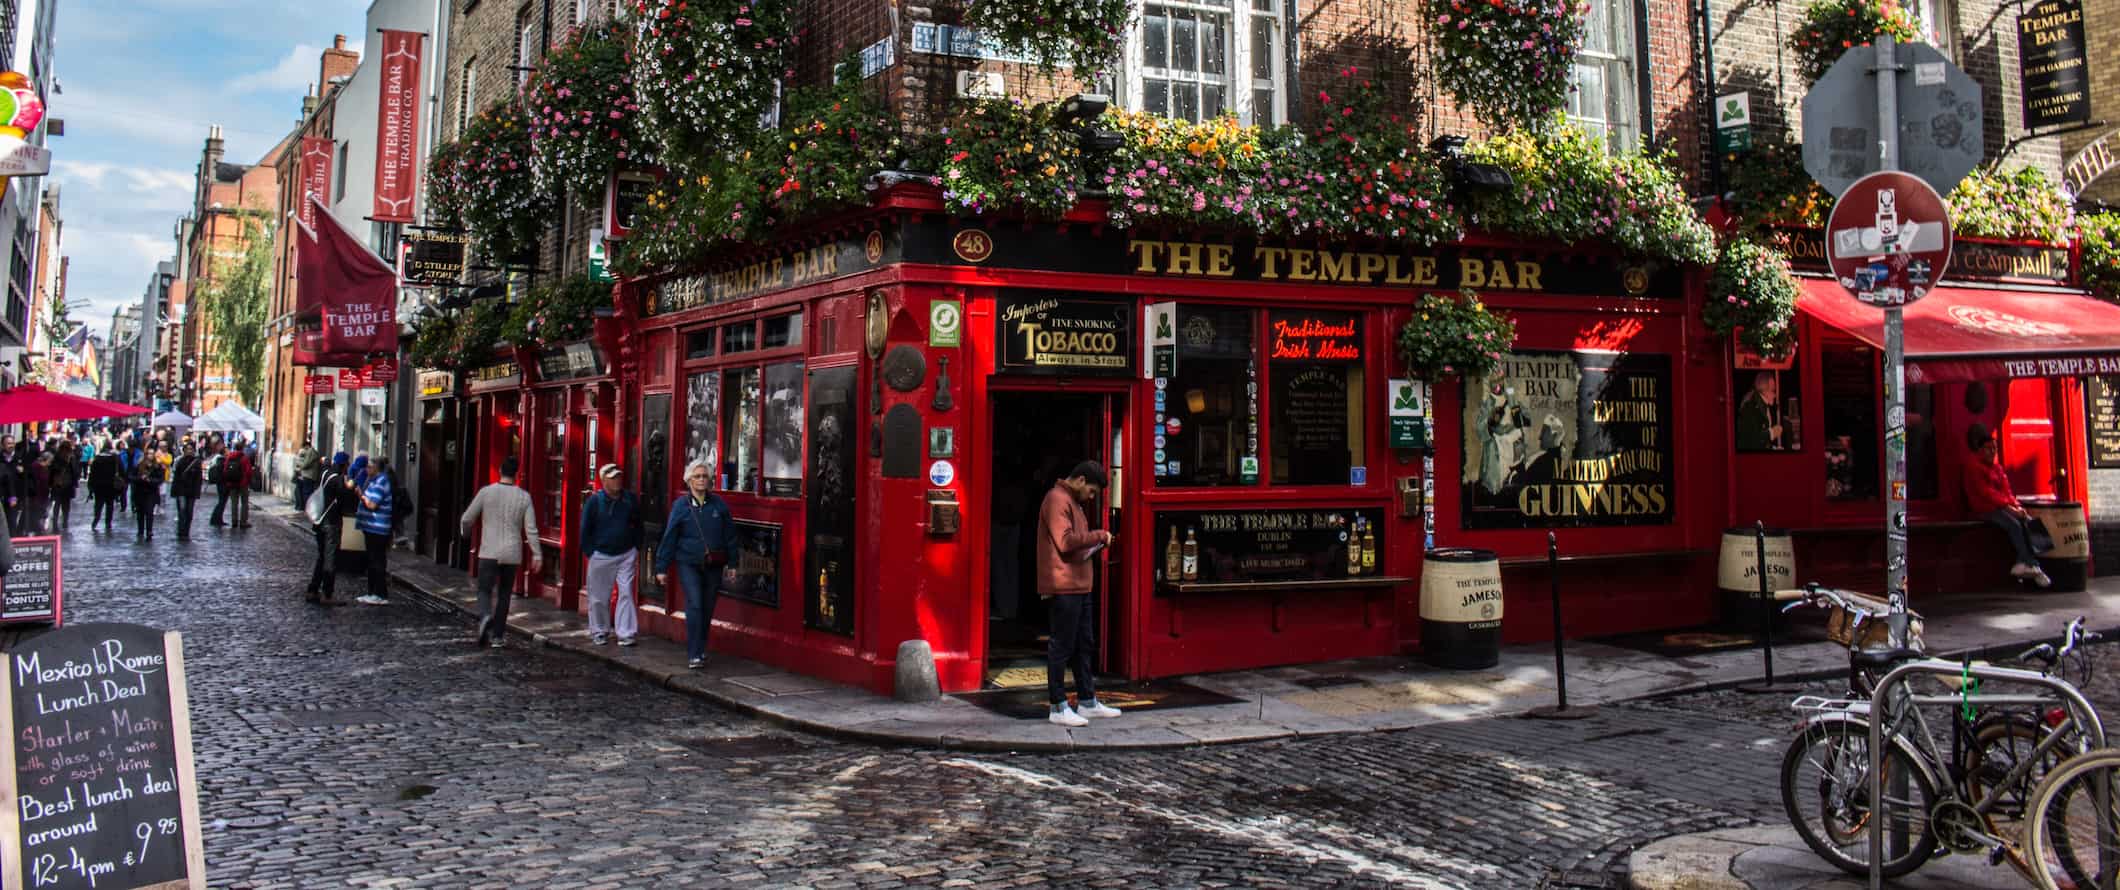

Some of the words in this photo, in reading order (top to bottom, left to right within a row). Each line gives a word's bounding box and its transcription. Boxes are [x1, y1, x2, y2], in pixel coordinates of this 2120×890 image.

[2039, 3, 2059, 15] THE
[2020, 10, 2080, 32] TEMPLE
[2035, 29, 2069, 46] BAR
[2047, 58, 2082, 72] GARDEN
[389, 65, 402, 95] BAR
[2029, 97, 2050, 109] LIVE
[2052, 92, 2082, 104] MUSIC
[2042, 104, 2070, 117] DAILY
[385, 98, 400, 157] TEMPLE
[400, 110, 412, 168] TRADING
[384, 160, 397, 190] THE
[2068, 143, 2115, 192] THE
[961, 234, 985, 254] 48
[711, 257, 783, 302] TEMPLE
[793, 244, 838, 284] BAR
[1130, 240, 1235, 277] THE
[1256, 247, 1437, 285] TEMPLE
[1459, 258, 1543, 289] BAR
[327, 310, 391, 326] TEMPLE
[345, 303, 372, 313] THE
[1002, 298, 1059, 321] Importers
[1037, 311, 1048, 320] OF
[343, 325, 376, 338] BAR
[1052, 318, 1073, 328] FINE
[1074, 319, 1116, 329] SMOKING
[1275, 319, 1356, 337] Traditional
[1017, 322, 1117, 360] TOBACCO
[1271, 338, 1310, 358] Irish
[1316, 339, 1359, 358] Music
[1037, 355, 1073, 366] Always
[2005, 360, 2037, 377] THE
[2038, 358, 2097, 375] TEMPLE
[1501, 362, 1575, 380] TEMPLE
[1525, 380, 1560, 399] BAR
[1629, 377, 1657, 398] THE
[1592, 400, 1657, 422] EMPEROR
[1641, 426, 1657, 446] OF
[1552, 457, 1608, 481] MALTED
[1518, 483, 1666, 517] GUINNESS
[1200, 514, 1236, 529] THE
[1240, 513, 1307, 529] TEMPLE
[8, 562, 49, 572] OFFEE
[1744, 564, 1790, 578] JAESON
[16, 651, 92, 687] Mexico
[101, 639, 164, 674] Rome
[37, 680, 100, 715] Lunch
[101, 673, 147, 703] Deal
[22, 719, 92, 752] Starter
[111, 708, 164, 737] Main
[18, 755, 45, 772] with
[51, 751, 90, 771] glass
[99, 743, 115, 763] of
[125, 740, 158, 754] wine
[40, 775, 56, 786] or
[71, 762, 105, 781] soft
[116, 758, 152, 773] drink
[19, 786, 77, 822] Best
[82, 777, 134, 808] lunch
[143, 768, 177, 795] deal
[27, 812, 98, 846] around
